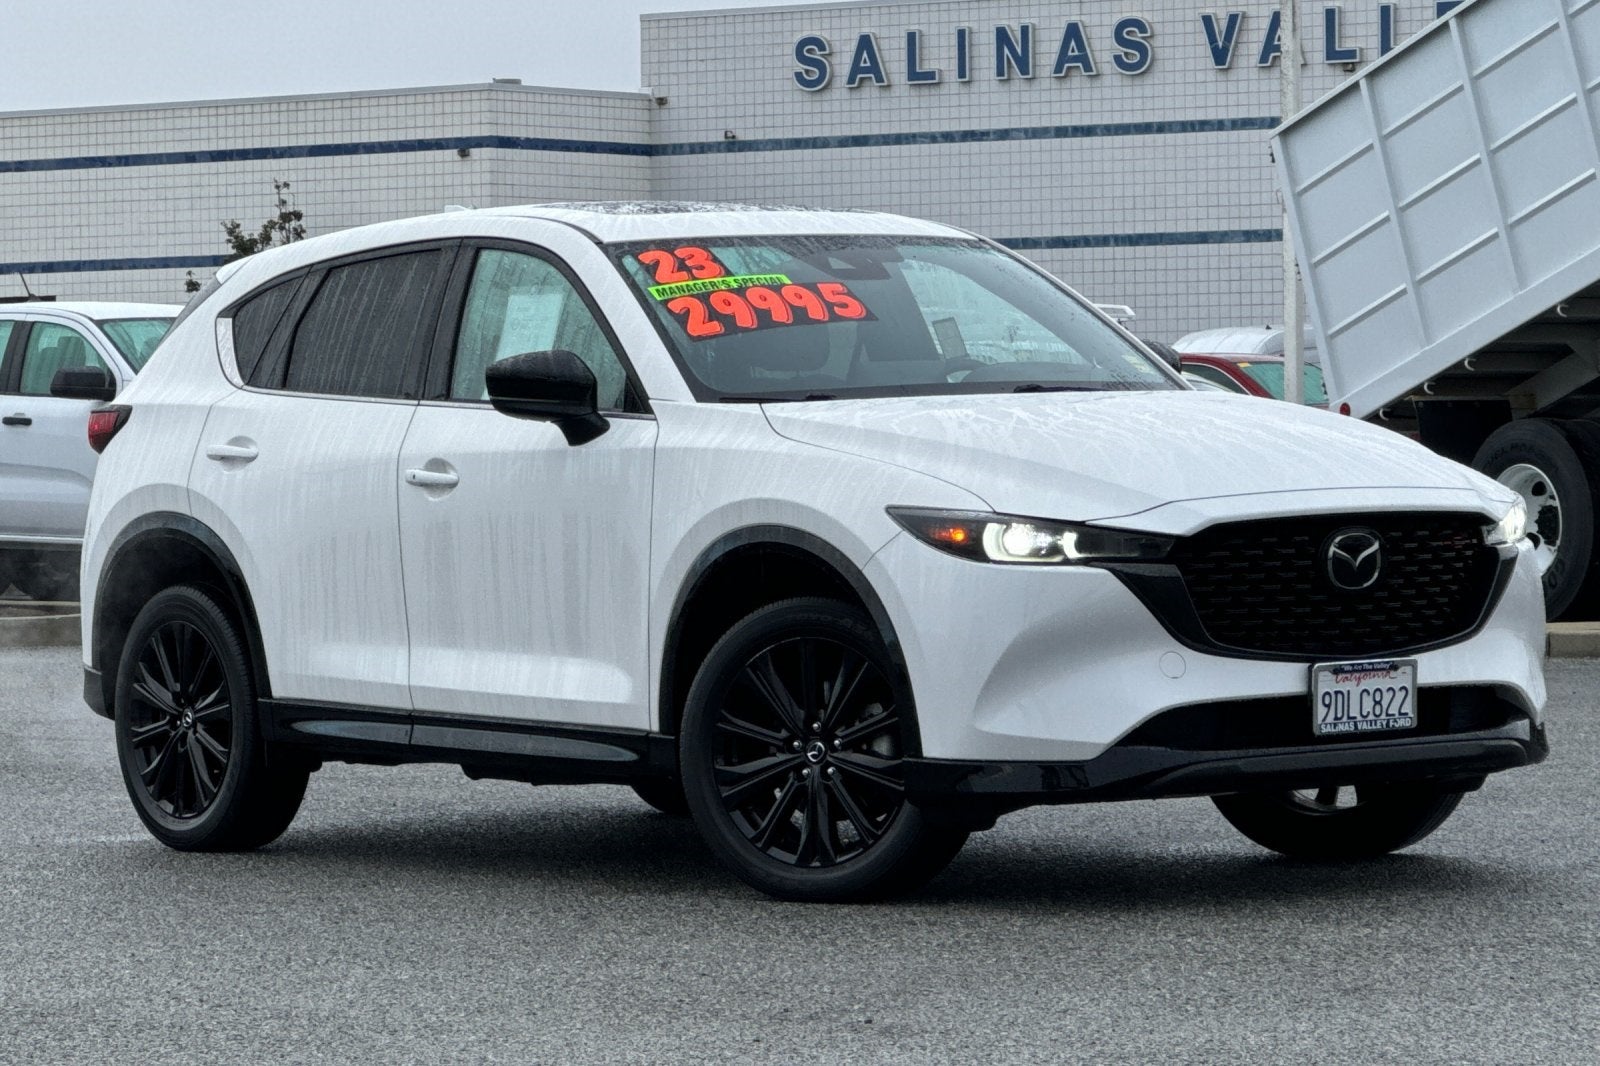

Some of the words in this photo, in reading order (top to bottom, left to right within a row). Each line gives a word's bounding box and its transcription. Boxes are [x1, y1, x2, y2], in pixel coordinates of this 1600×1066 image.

[793, 16, 1154, 92] SALINAS
[638, 246, 726, 284] 23
[667, 282, 867, 338] 29995
[1322, 686, 1409, 722] 9DLC822
[1321, 723, 1355, 733] SALINAS
[1357, 721, 1388, 730] VALLEY
[1389, 718, 1412, 728] FORD
